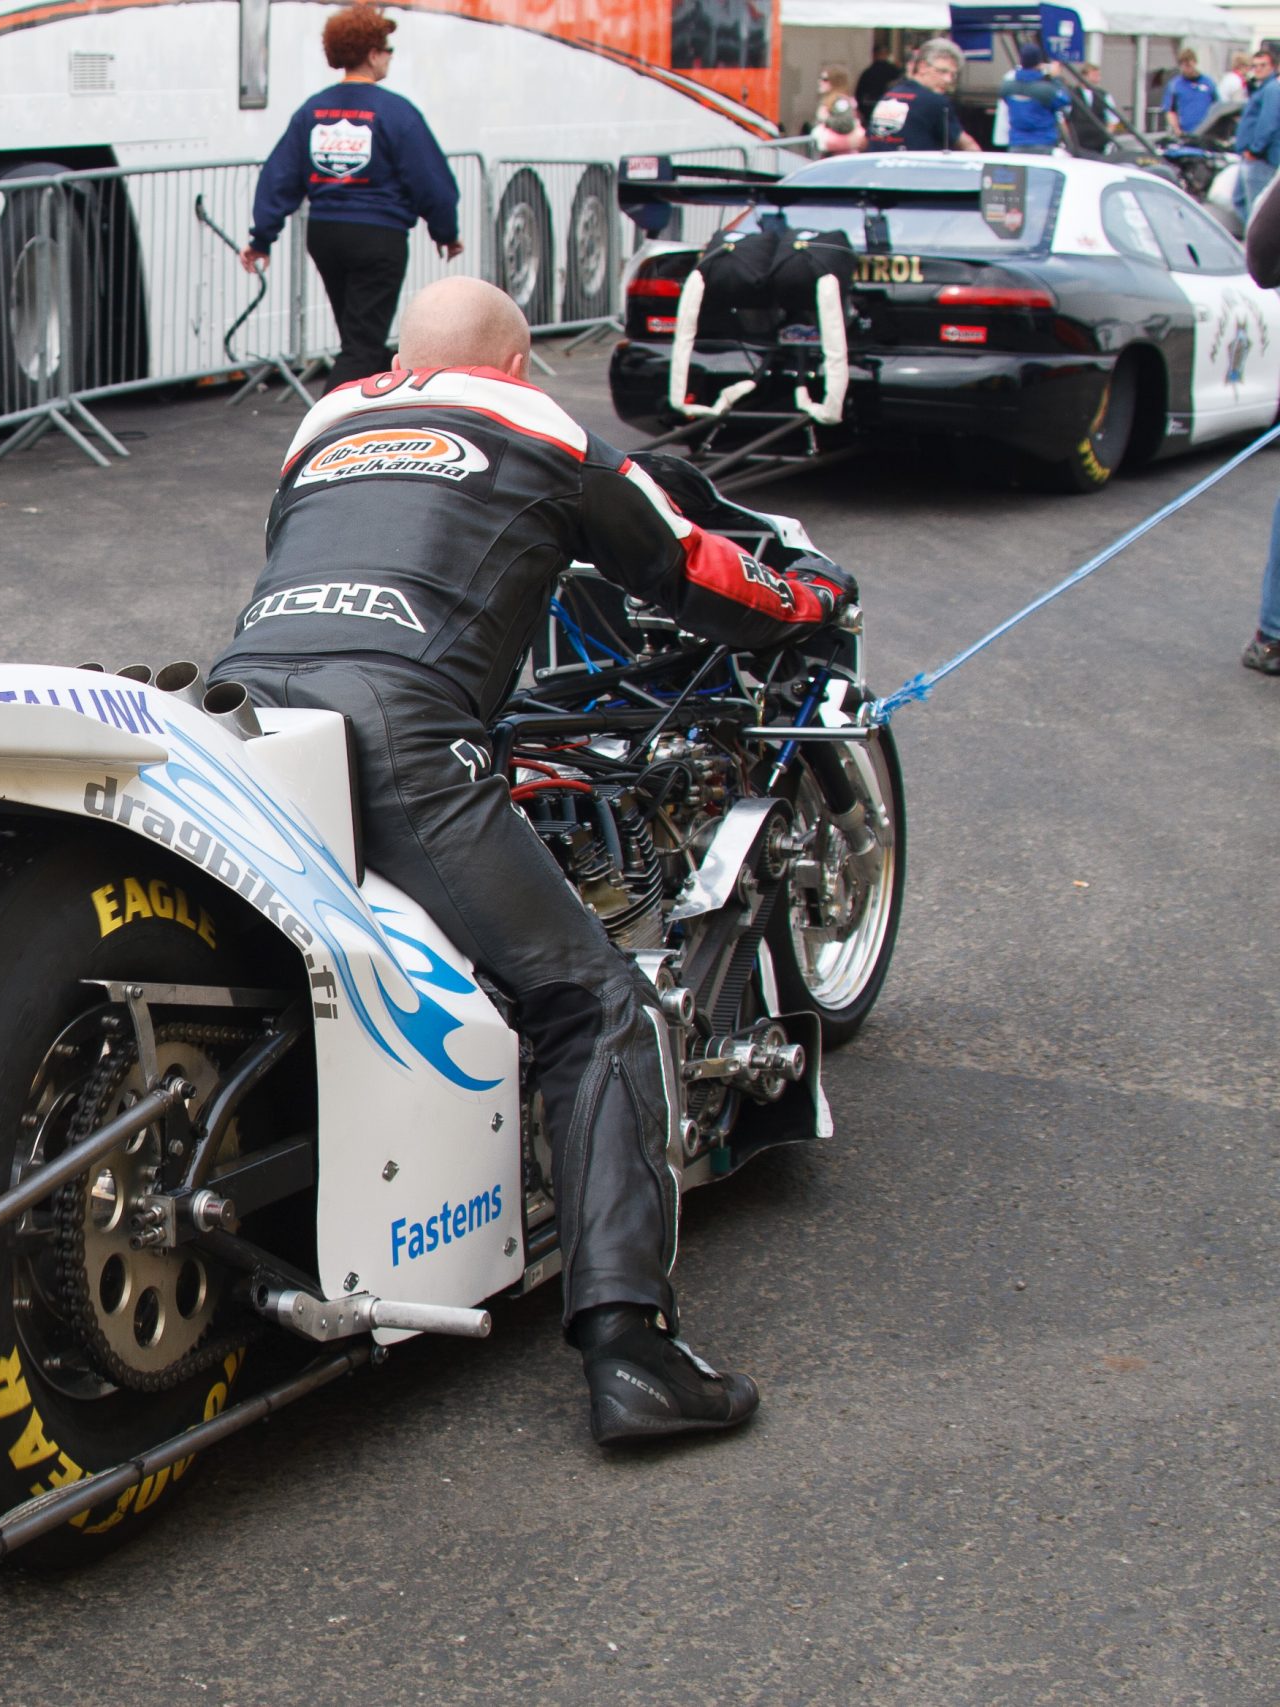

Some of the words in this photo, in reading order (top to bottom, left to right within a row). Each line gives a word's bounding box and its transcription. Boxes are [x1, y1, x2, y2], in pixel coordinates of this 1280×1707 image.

[321, 440, 432, 466] db-team
[244, 583, 426, 633] RICHA
[84, 776, 338, 1019] dragbike.fi
[91, 877, 217, 949] EAGLE
[391, 1184, 502, 1267] Fastems
[616, 1369, 670, 1408] RICHA
